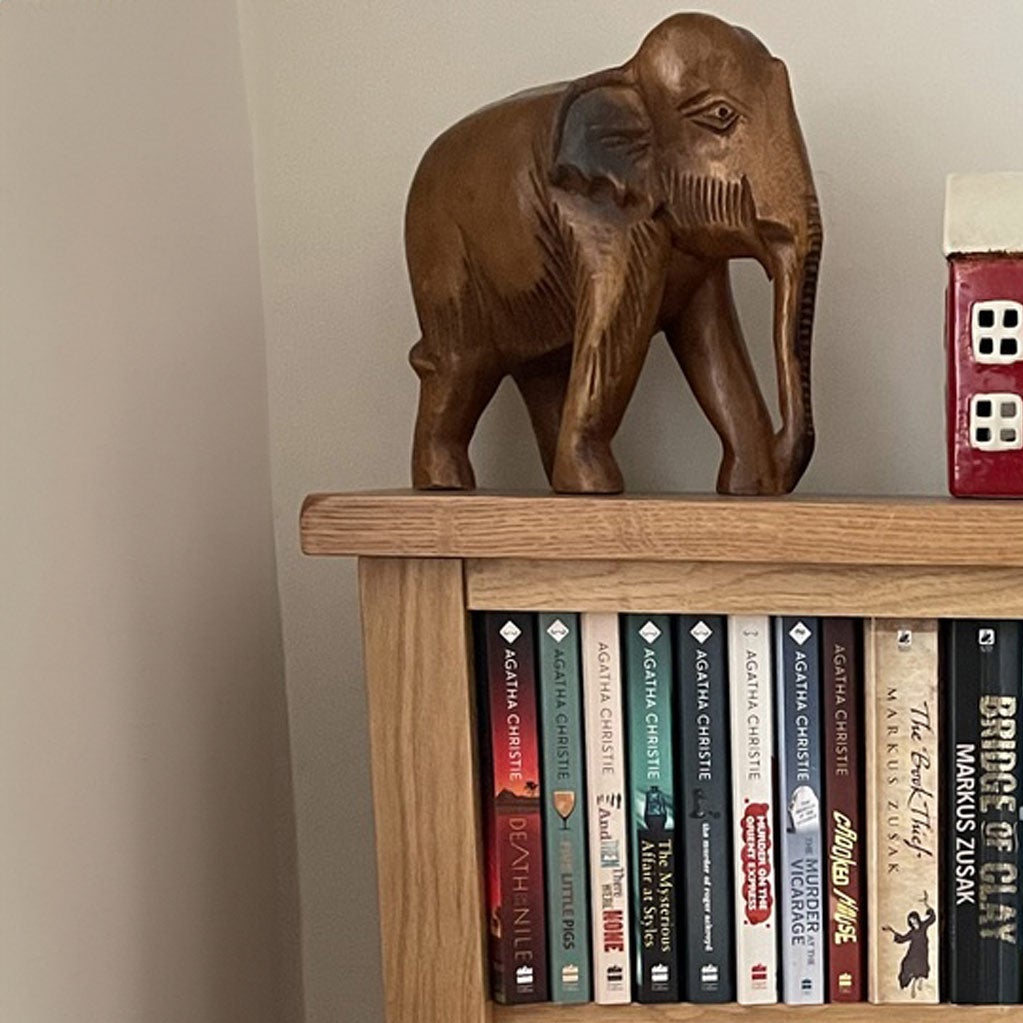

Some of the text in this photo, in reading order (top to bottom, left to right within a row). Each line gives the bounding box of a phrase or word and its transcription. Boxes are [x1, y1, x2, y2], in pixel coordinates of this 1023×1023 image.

[504, 648, 523, 782] AGATHA CHRISTIE
[553, 648, 571, 780] AGATHA CHRISTIE
[597, 642, 615, 775] AGATHA CHRISTIE
[643, 648, 661, 780] AGATHA CHRISTIE
[696, 649, 712, 781] AGATHA CHRISTIE
[746, 650, 762, 780] AGATHA CHRISTIE
[795, 651, 811, 781] AGATHA CHRISTIE
[833, 644, 849, 777] AGATHA CHRISTIE
[887, 687, 899, 874] MARKUS ZUSAK
[903, 701, 934, 856] The Book Thief
[956, 743, 976, 906] MARKUS ZUSAK
[979, 695, 1018, 944] BRIDGE OF CLAY
[563, 920, 577, 951] PIGS
[603, 910, 624, 953] NONE
[641, 840, 659, 950] Affair Styles
[658, 840, 676, 953] The Mysterious
[791, 859, 805, 946] VICARAGE
[806, 859, 819, 933] MURDER
